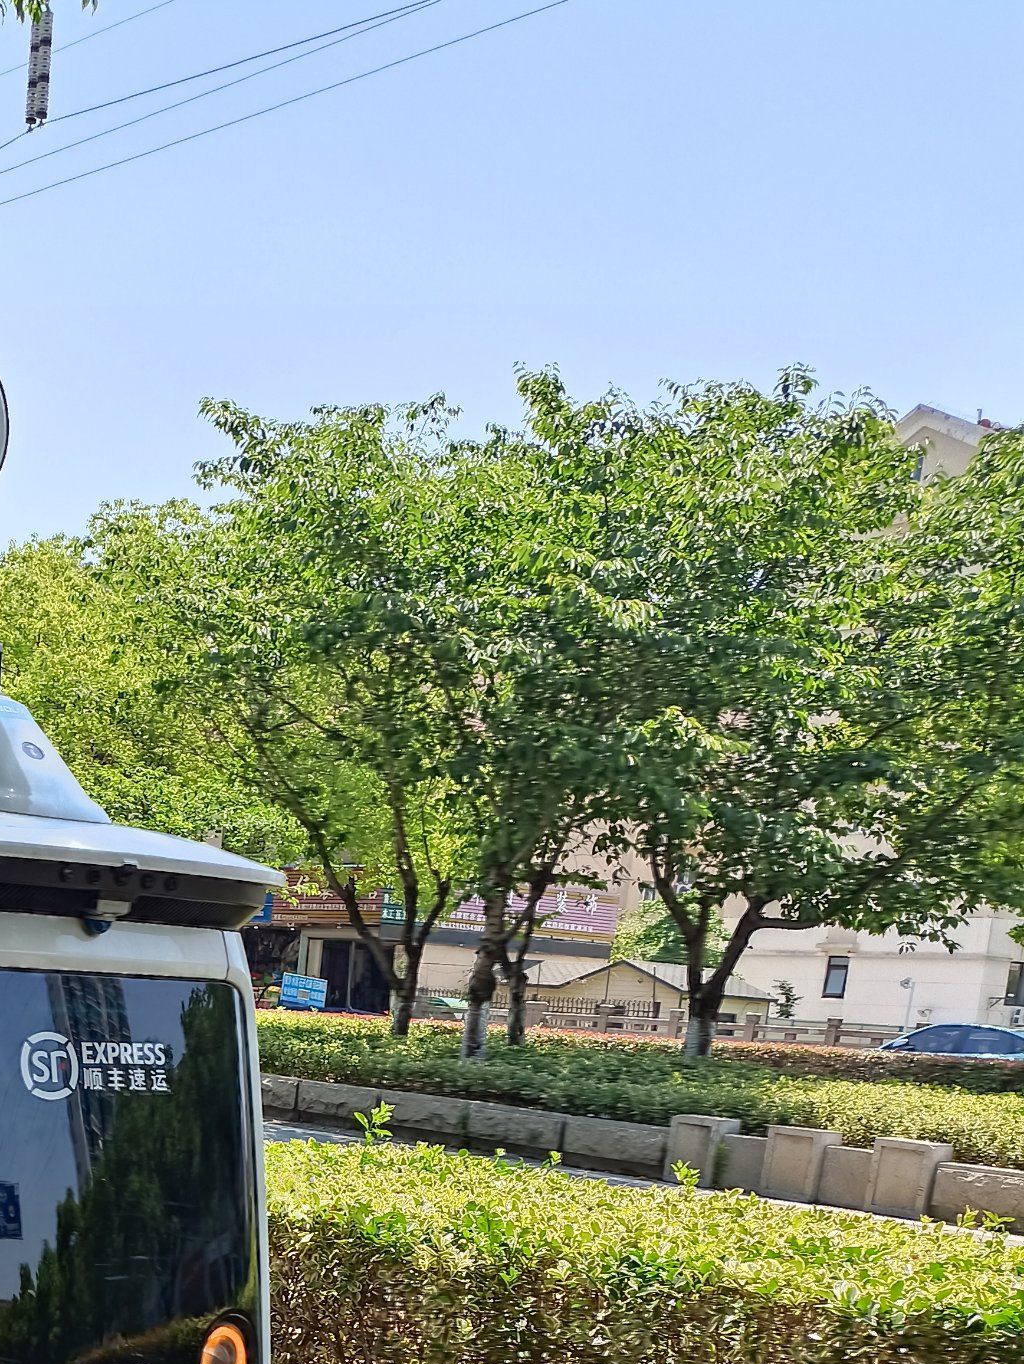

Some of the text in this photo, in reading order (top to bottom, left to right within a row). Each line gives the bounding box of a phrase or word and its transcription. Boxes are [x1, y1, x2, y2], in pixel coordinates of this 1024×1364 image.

[81, 1041, 166, 1066] EXPRESS
[83, 1067, 169, 1092] 顺丰速运
